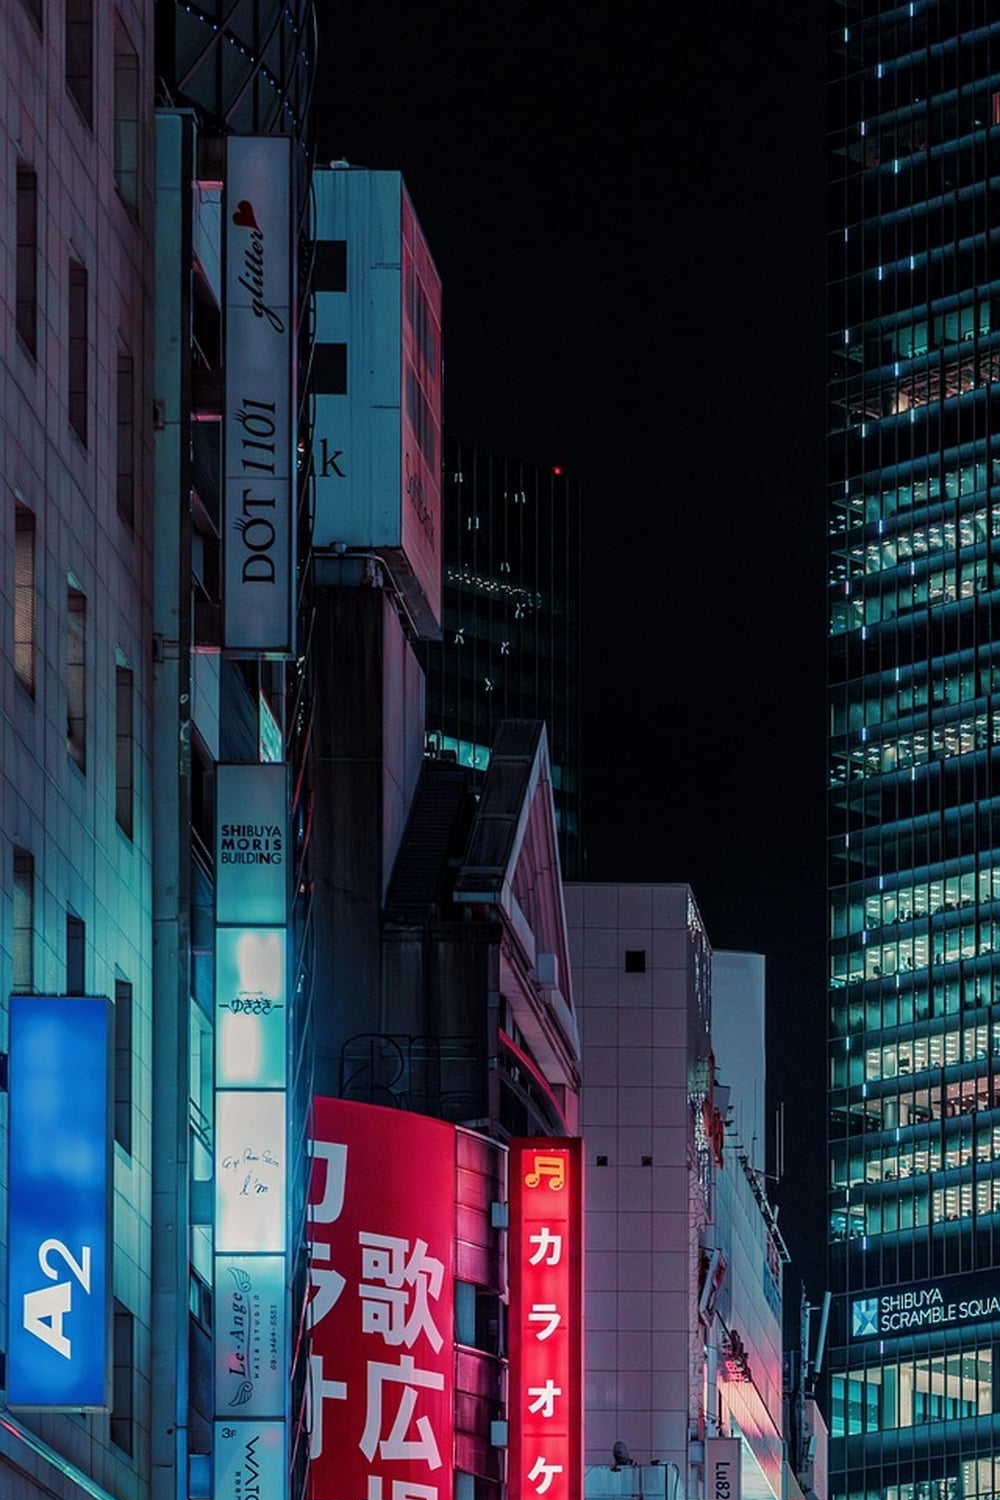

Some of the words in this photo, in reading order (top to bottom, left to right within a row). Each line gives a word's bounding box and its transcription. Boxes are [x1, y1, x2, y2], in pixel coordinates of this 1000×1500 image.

[236, 229, 285, 334] glitter
[235, 398, 276, 475] 1101
[235, 489, 276, 584] DOT
[221, 824, 282, 837] SHIBUYA
[221, 838, 282, 851] MORIS
[221, 852, 282, 865] BUILDING
[230, 997, 274, 1015] ゆきざき
[23, 1238, 92, 1360] A2
[881, 1288, 944, 1314] SHIBUYA
[881, 1304, 957, 1332] SCRAMBLE
[221, 1427, 236, 1439] 3F
